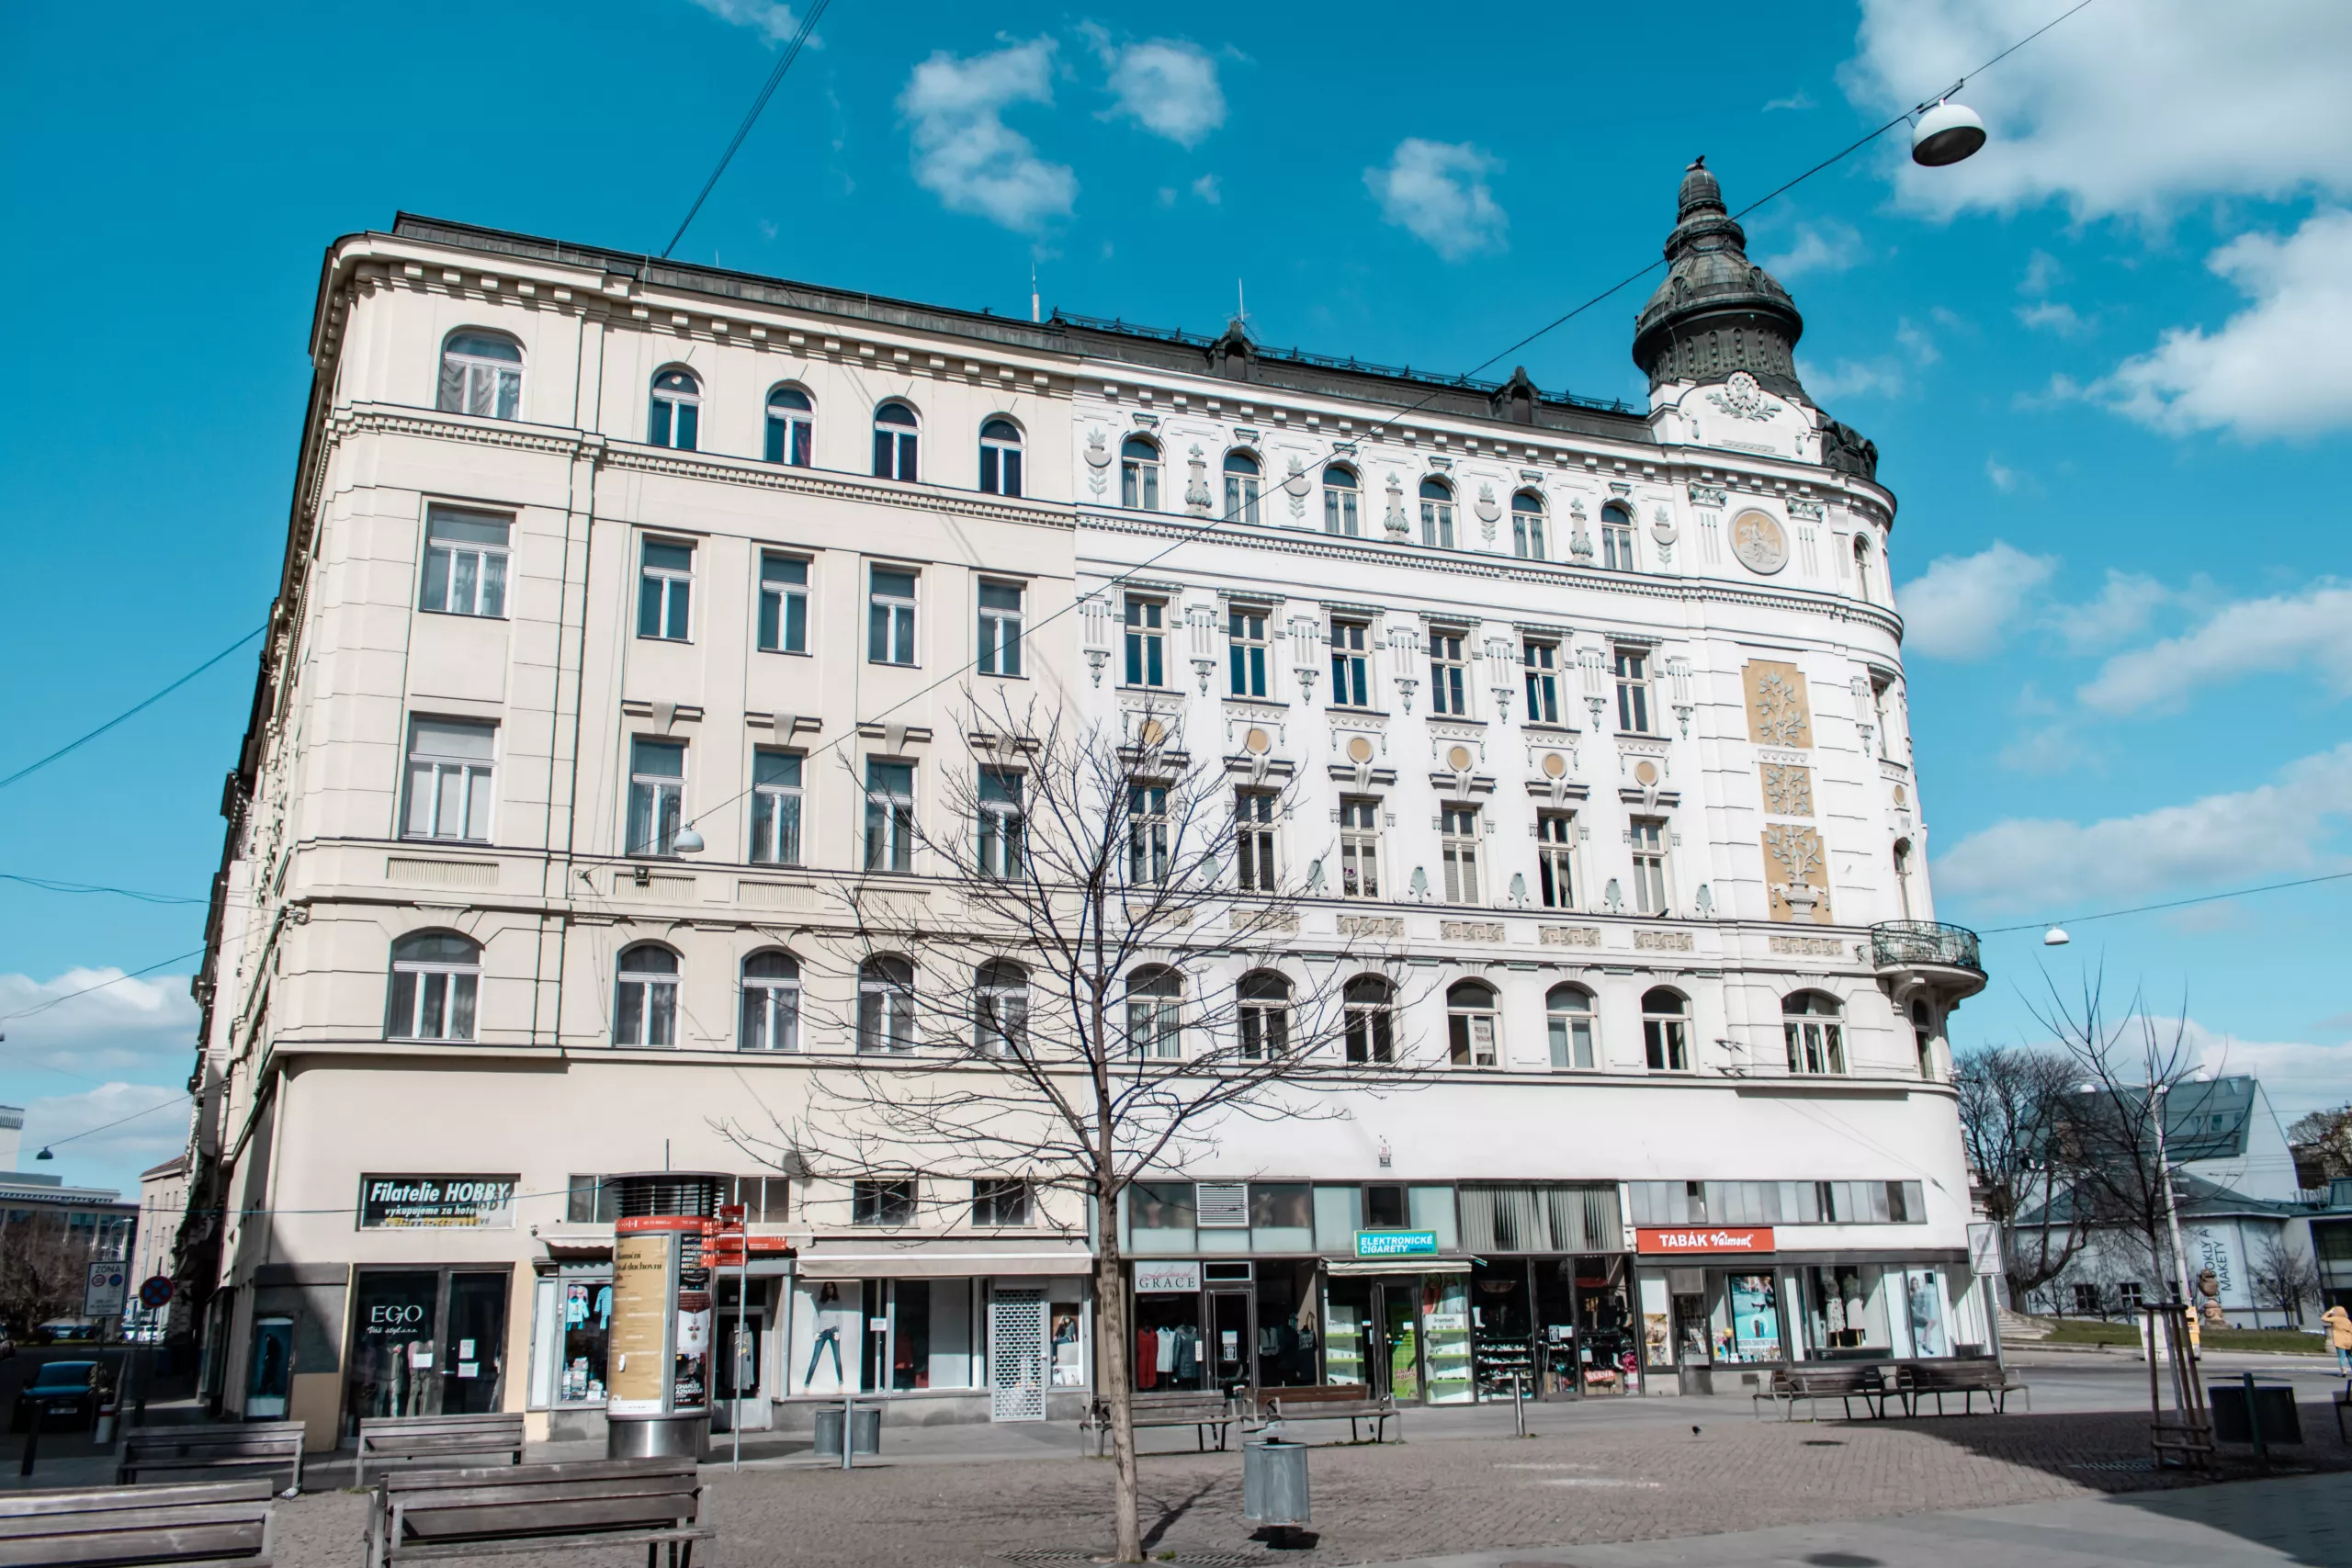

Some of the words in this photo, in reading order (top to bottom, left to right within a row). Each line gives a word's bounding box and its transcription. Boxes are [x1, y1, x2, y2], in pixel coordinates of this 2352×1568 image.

[370, 1181, 440, 1201] Filatelie
[445, 1182, 510, 1201] HOBBY
[385, 1205, 438, 1217] vykupujeme
[441, 1207, 452, 1215] za
[1361, 1234, 1433, 1246] ELEKTRONICKÉ
[1658, 1232, 1708, 1247] TABÁK
[1710, 1231, 1752, 1247] Valmont
[1361, 1245, 1408, 1254] CIGARETY
[628, 1261, 662, 1270] duchovní
[2213, 1241, 2232, 1292] MAKETY
[1139, 1277, 1196, 1289] GRACE
[370, 1305, 423, 1324] EGO
[1587, 1370, 1614, 1380] SLEVA
